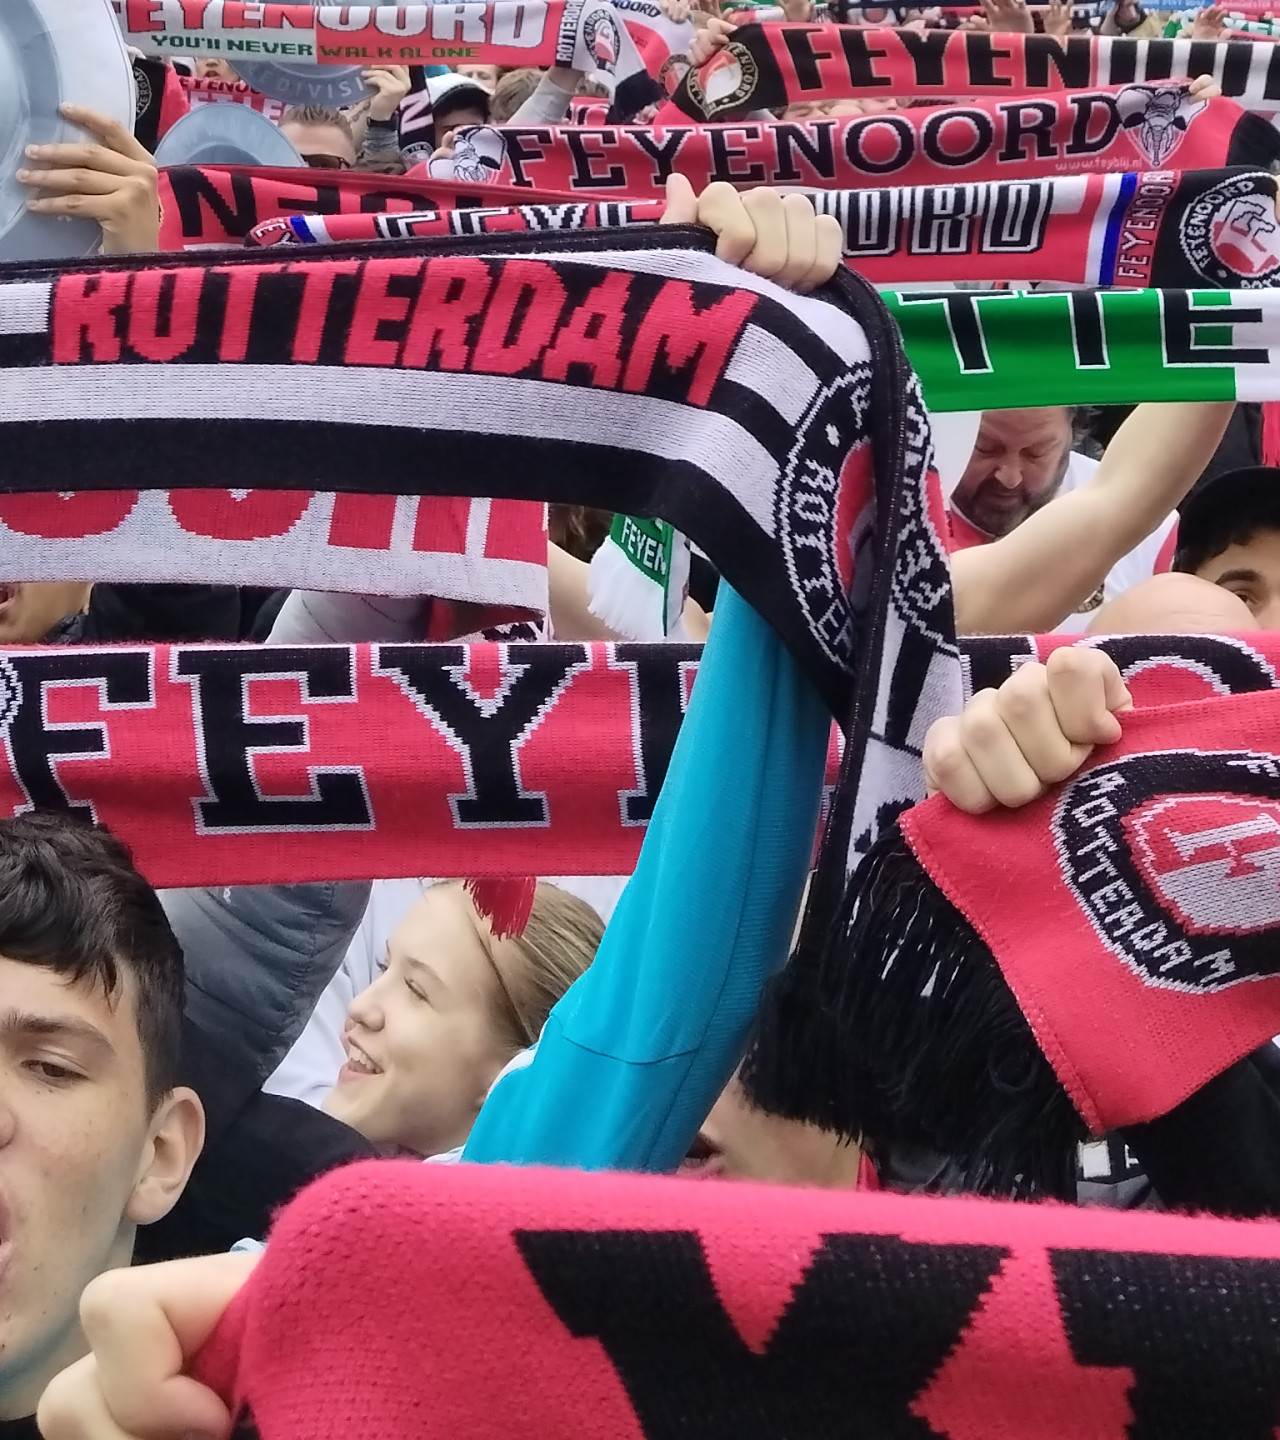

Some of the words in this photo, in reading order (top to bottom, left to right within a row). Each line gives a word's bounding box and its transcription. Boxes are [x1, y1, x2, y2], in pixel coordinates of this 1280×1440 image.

[227, 38, 315, 57] NEVER
[319, 45, 394, 59] WALK
[400, 46, 481, 59] ALONE
[502, 92, 1122, 189] FEYENOORD
[51, 257, 758, 408] ROTTERDAM
[1099, 770, 1236, 988] ROTTERDAM
